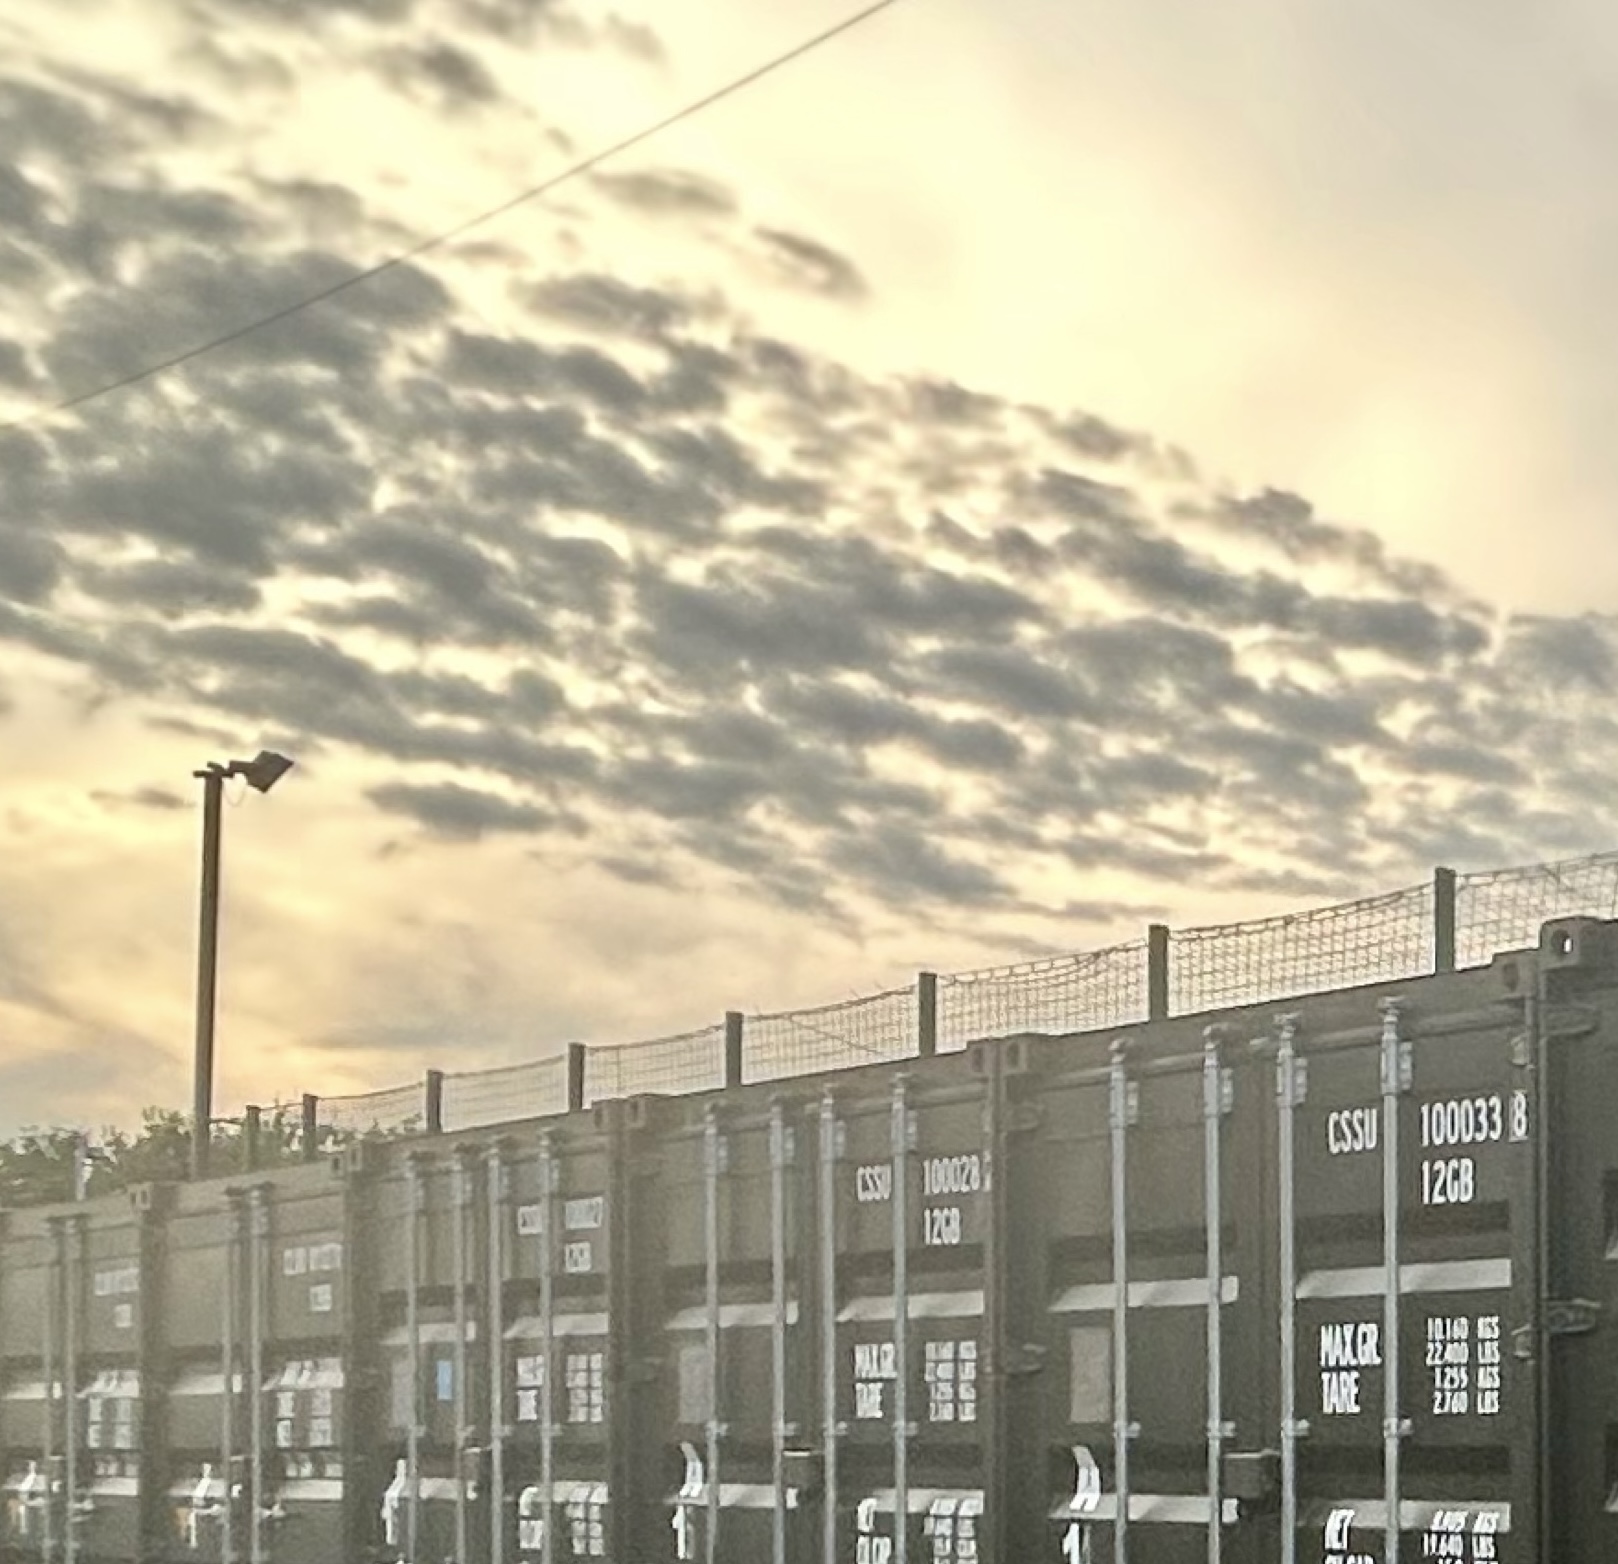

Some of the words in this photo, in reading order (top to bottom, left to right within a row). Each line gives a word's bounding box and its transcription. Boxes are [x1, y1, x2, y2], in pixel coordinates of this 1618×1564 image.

[1328, 1108, 1378, 1154] CSSU
[1421, 1095, 1502, 1147] 100033
[1513, 1091, 1528, 1138] 8
[1422, 1157, 1474, 1204] 12GB
[1321, 1371, 1360, 1413] TARE
